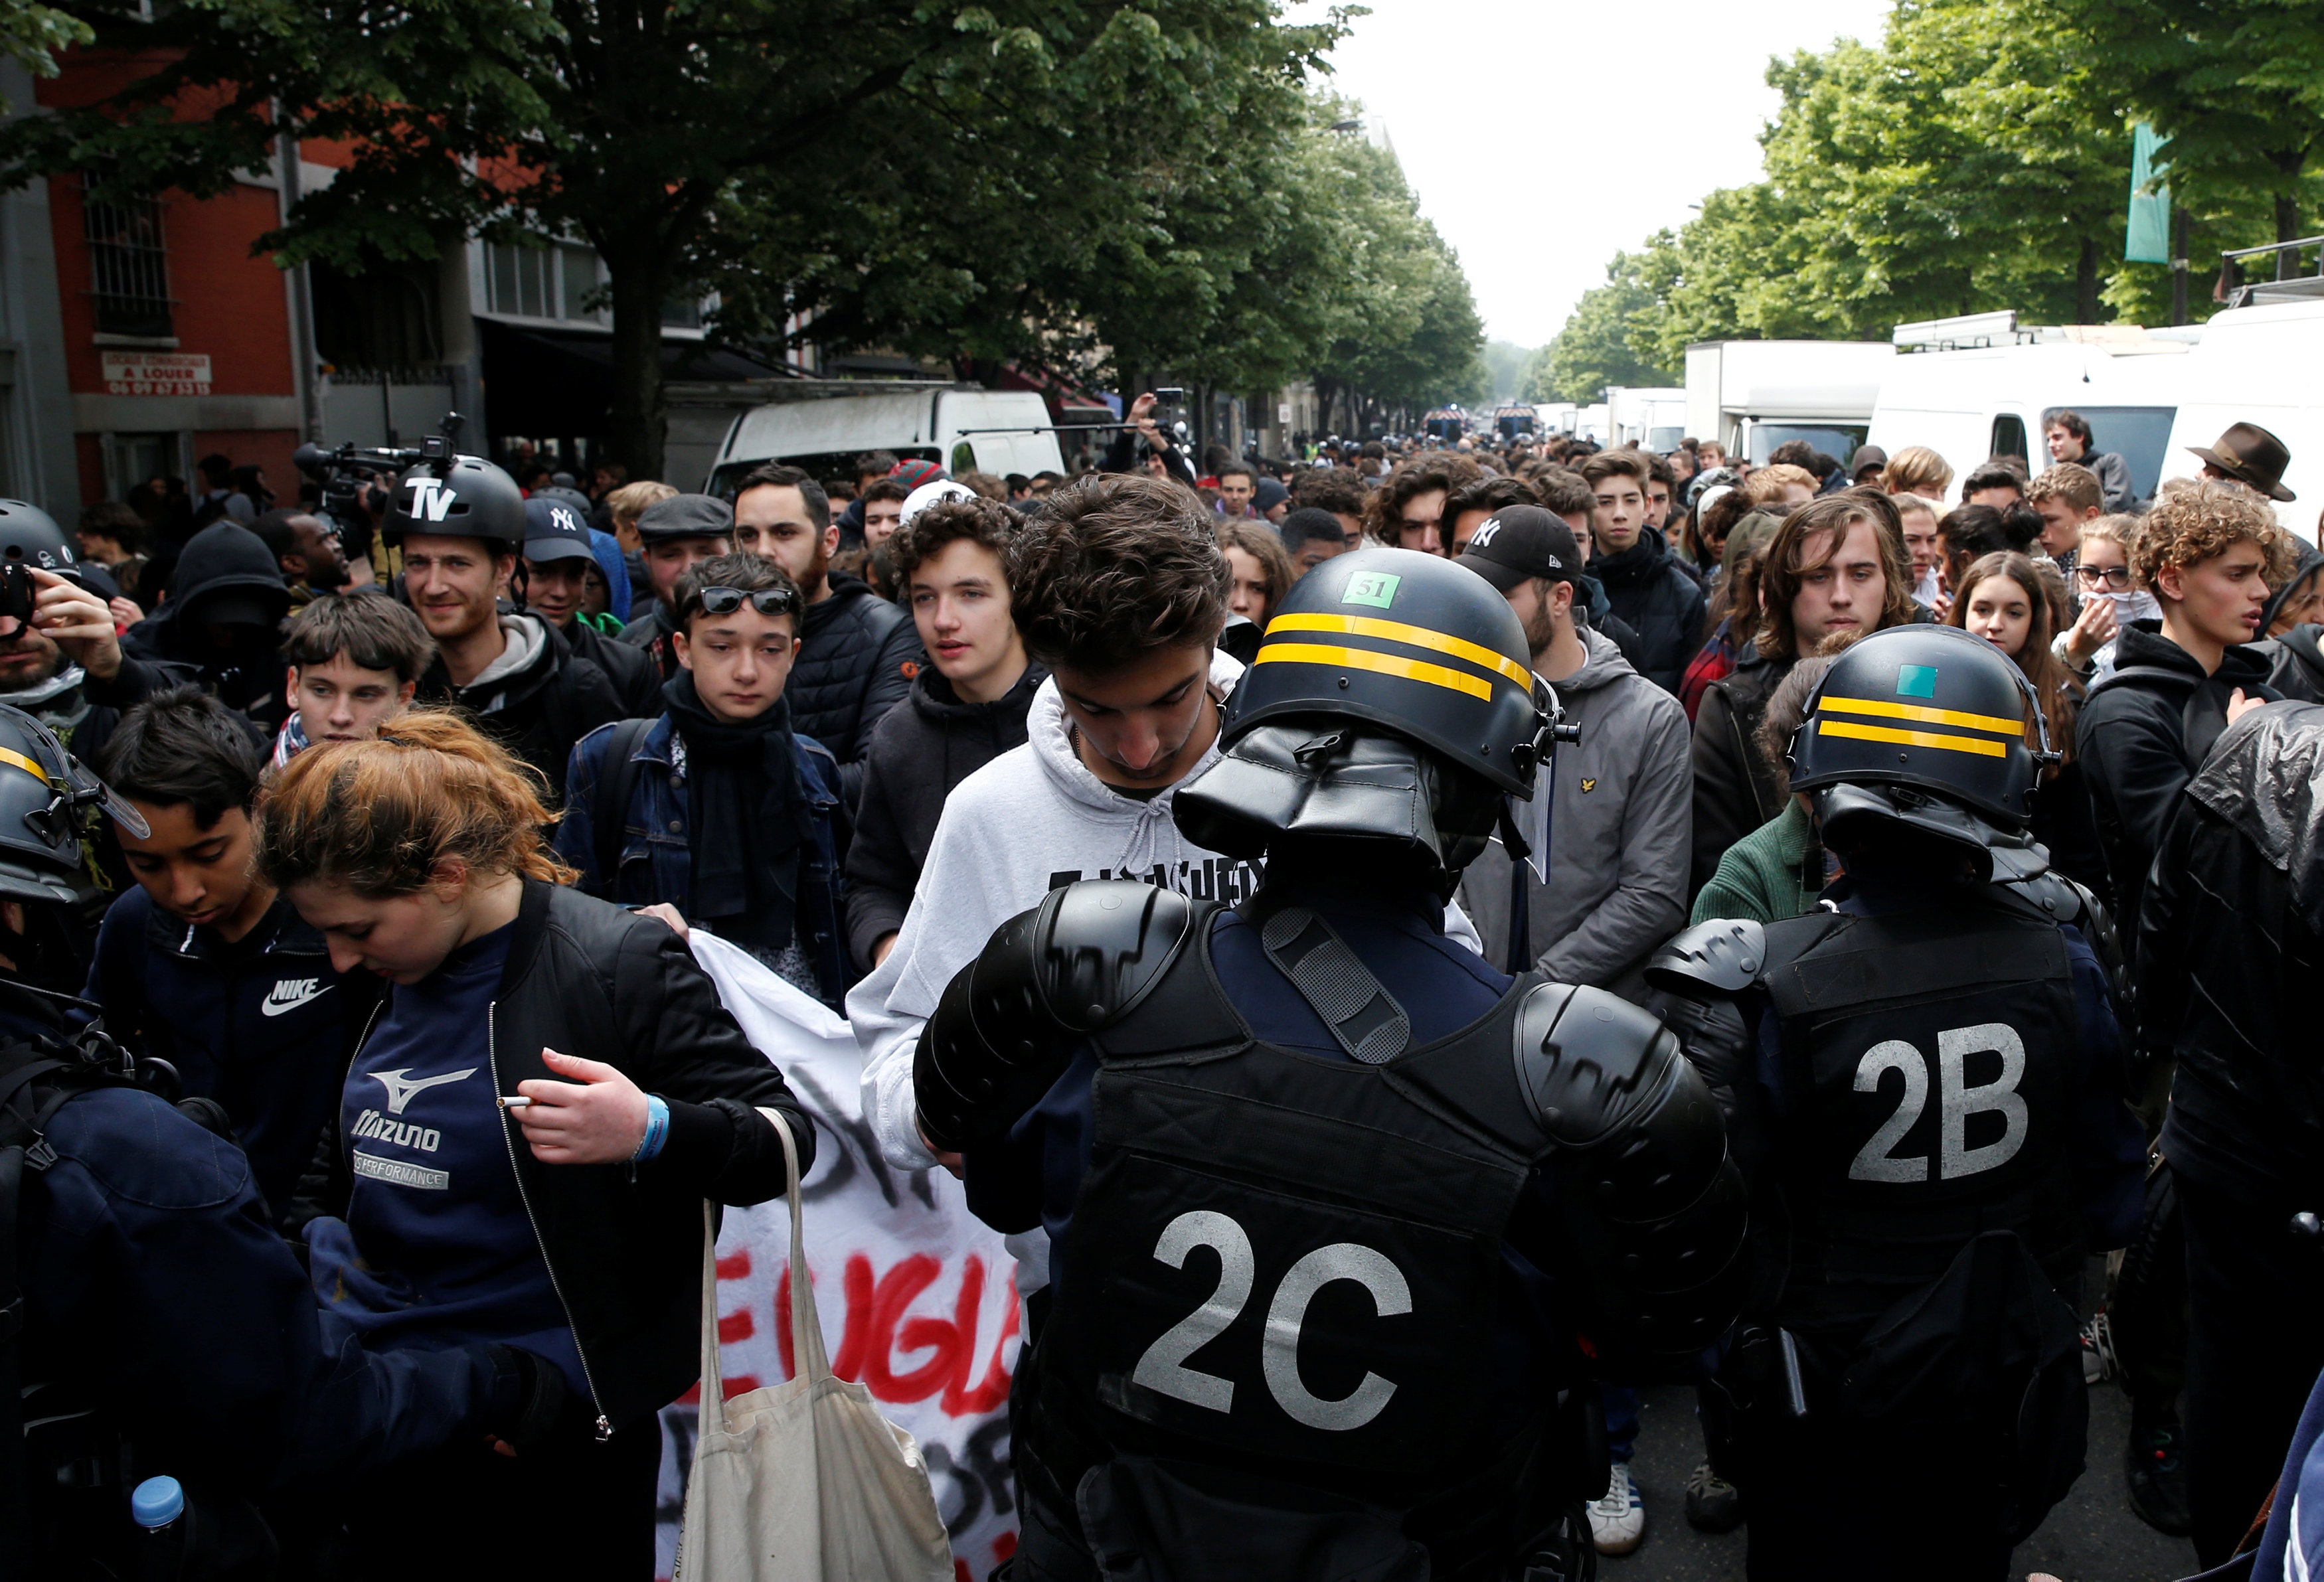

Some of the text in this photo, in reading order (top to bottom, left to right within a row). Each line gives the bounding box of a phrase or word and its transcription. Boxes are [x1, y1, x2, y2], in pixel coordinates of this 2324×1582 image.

[124, 367, 195, 379] A LOUER
[550, 507, 576, 531] NY
[1470, 518, 1501, 547] NY
[1356, 579, 1386, 599] 51
[272, 978, 319, 1000] NIKE
[1849, 1023, 2028, 1183] 2B
[363, 1158, 443, 1186] PERFORMANCE
[1133, 1210, 1412, 1431] 2C
